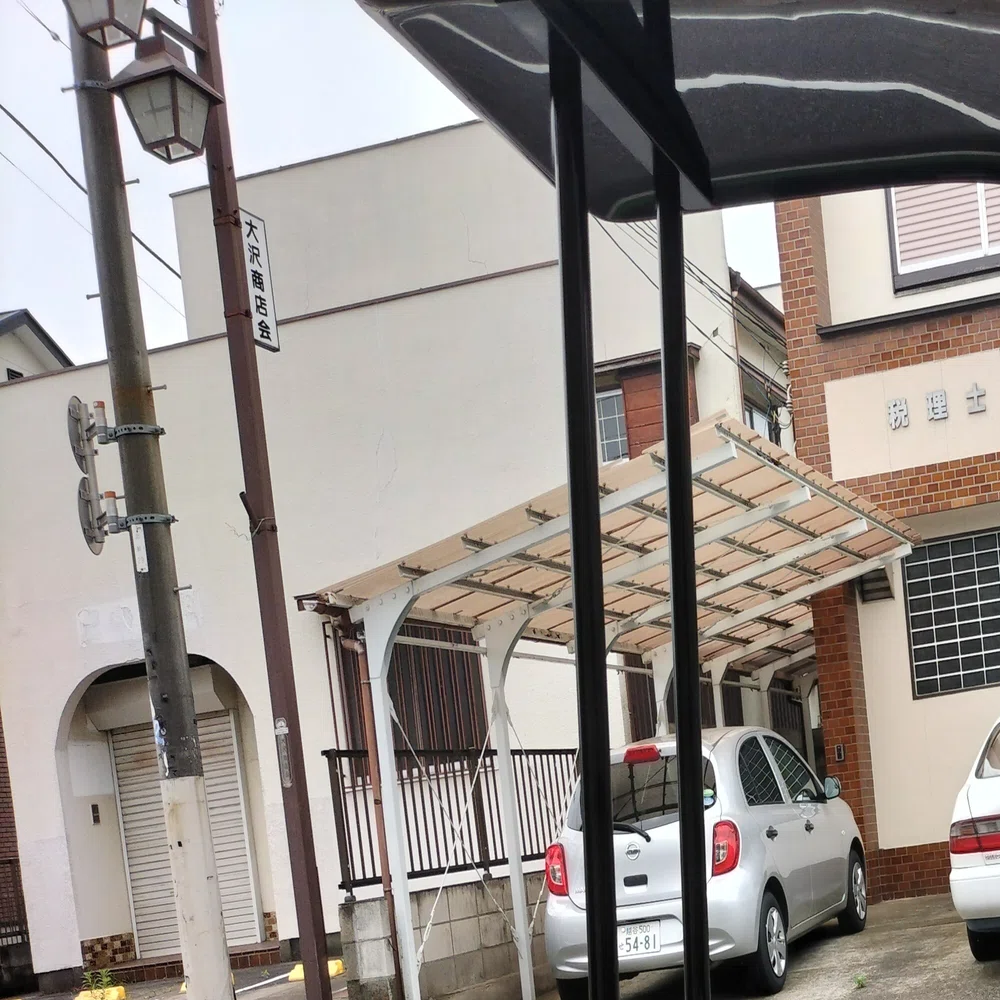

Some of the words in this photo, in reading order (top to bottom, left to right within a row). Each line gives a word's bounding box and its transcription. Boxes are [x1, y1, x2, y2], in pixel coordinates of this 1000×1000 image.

[244, 219, 272, 342] 大沢商店会
[625, 934, 656, 953] 54-81
